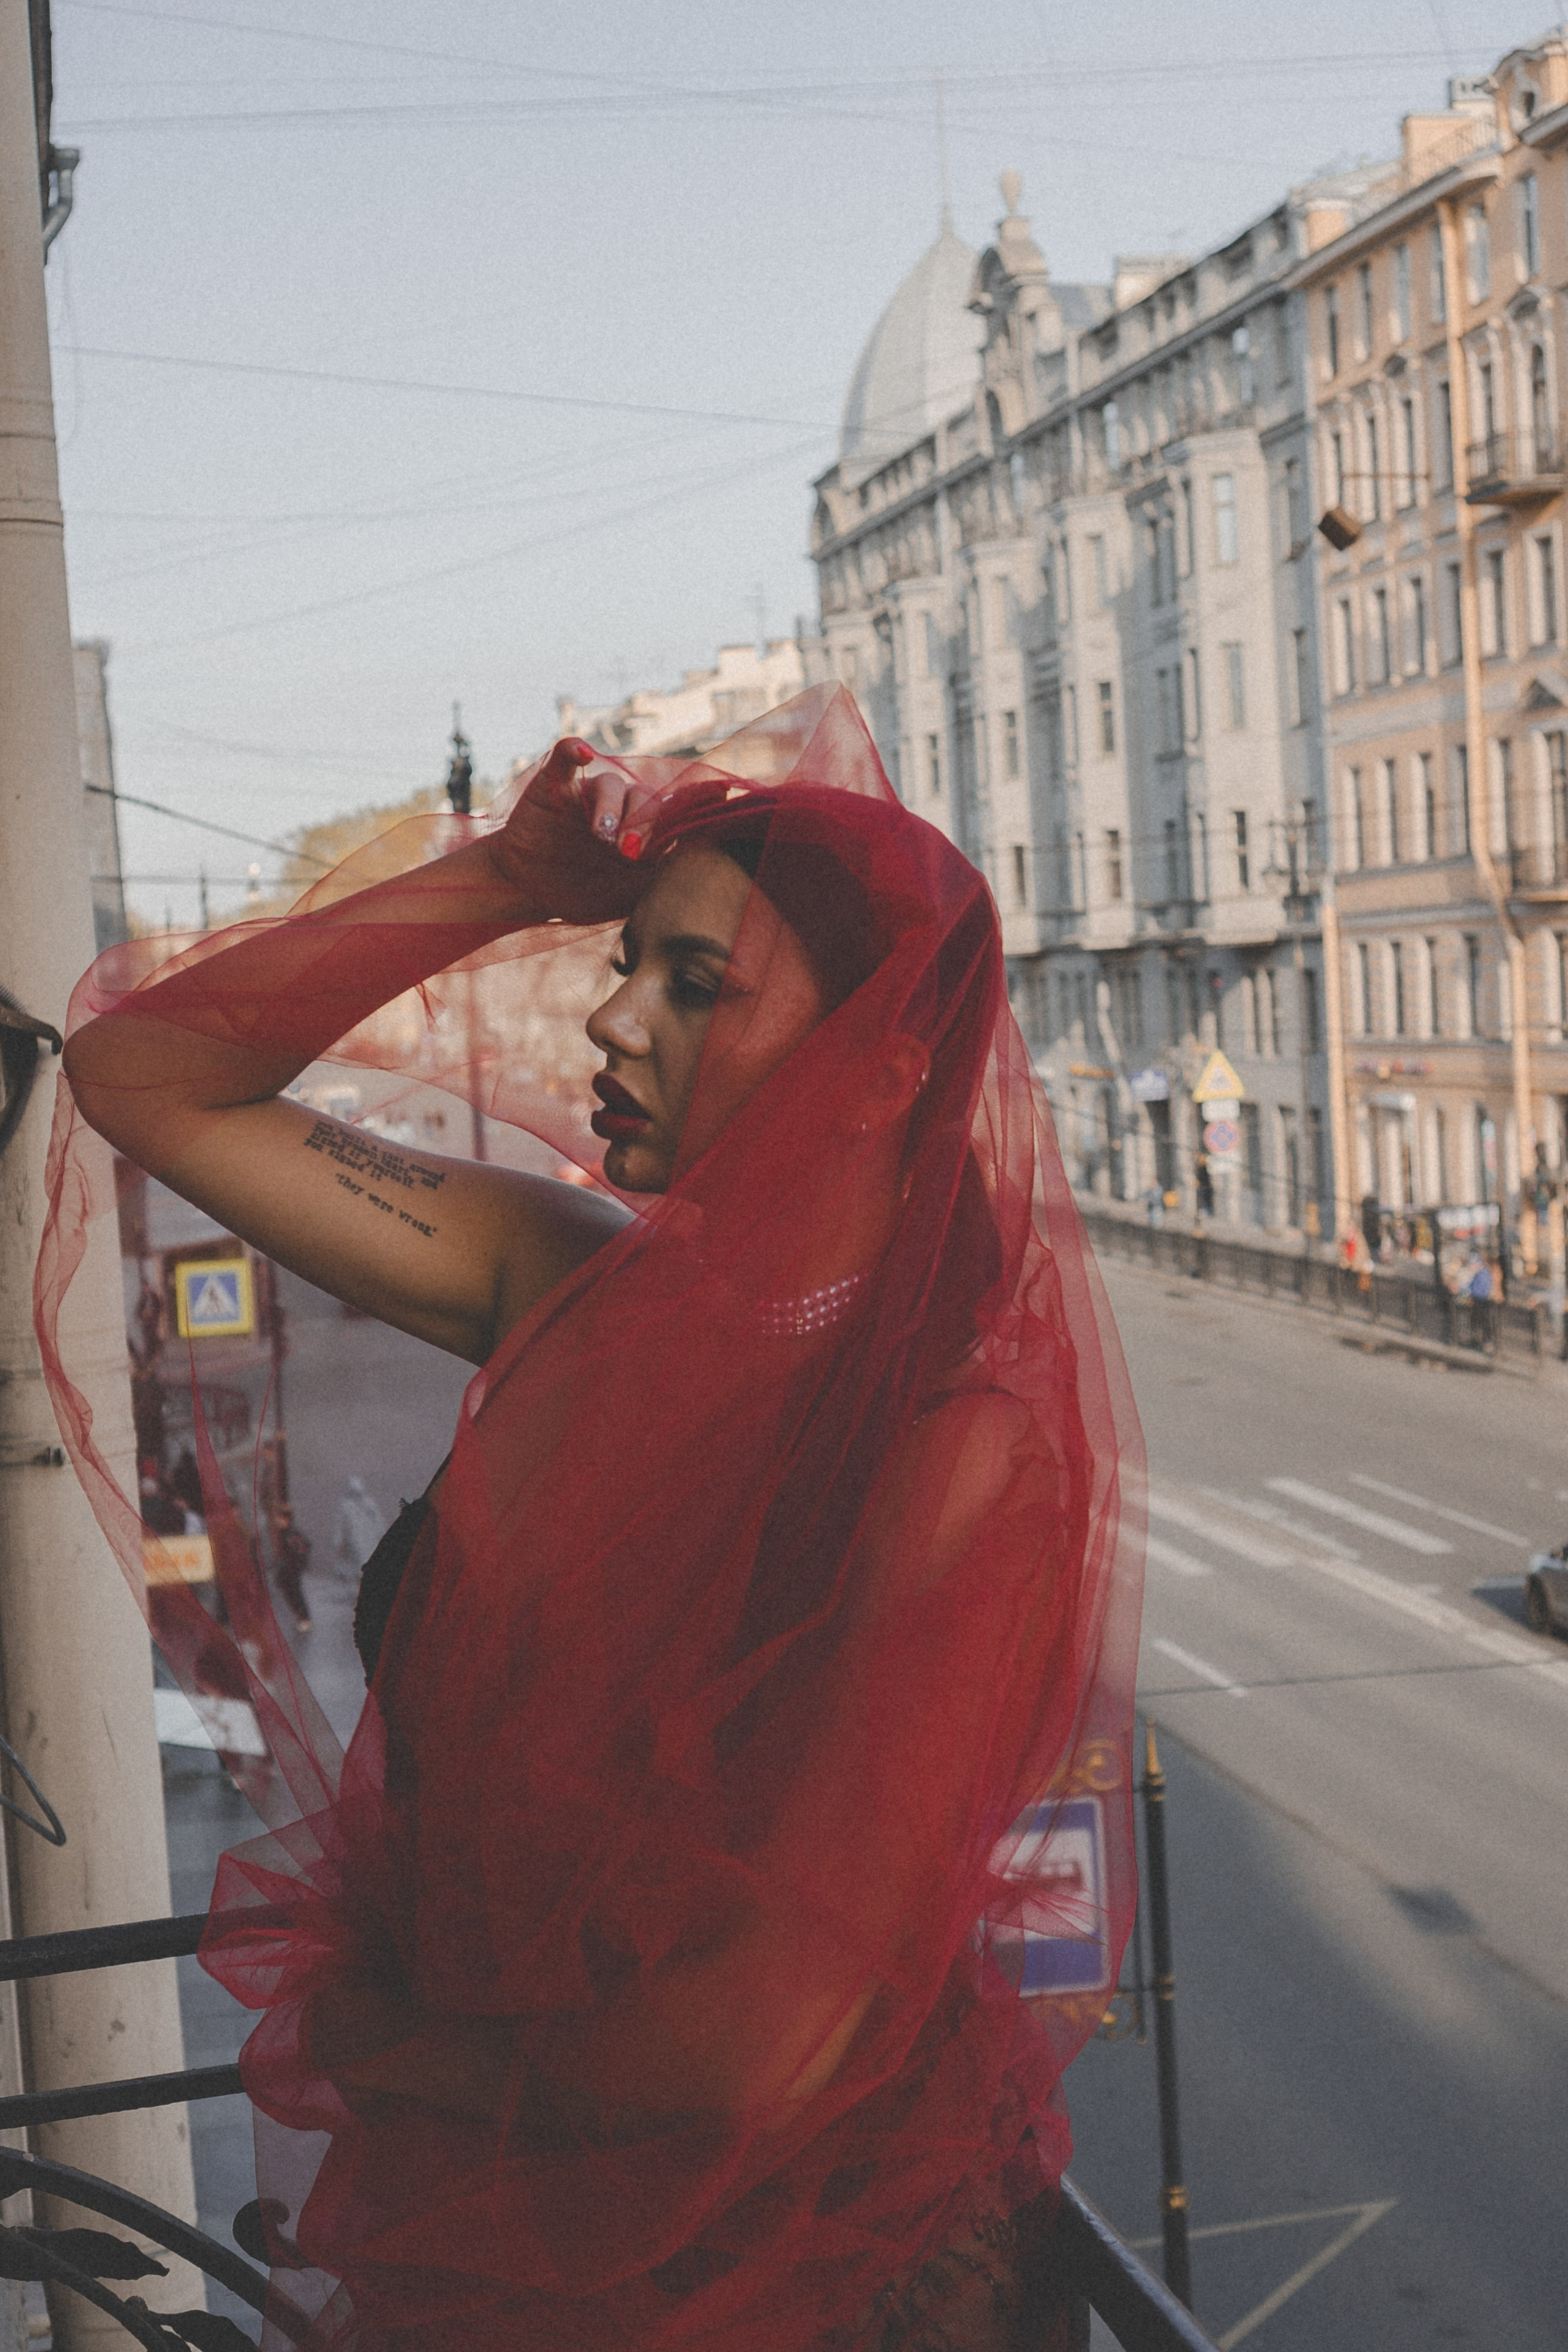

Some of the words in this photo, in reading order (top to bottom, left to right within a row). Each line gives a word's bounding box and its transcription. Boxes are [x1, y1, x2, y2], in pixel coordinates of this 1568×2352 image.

[311, 1133, 345, 1152] signed
[350, 1150, 361, 1160] it
[314, 1126, 336, 1138] your
[342, 1136, 377, 1159] broken
[304, 1138, 323, 1152] you
[328, 1149, 364, 1172] signed
[370, 1169, 382, 1182] it
[409, 1164, 445, 1183] around
[368, 1193, 394, 1213] were
